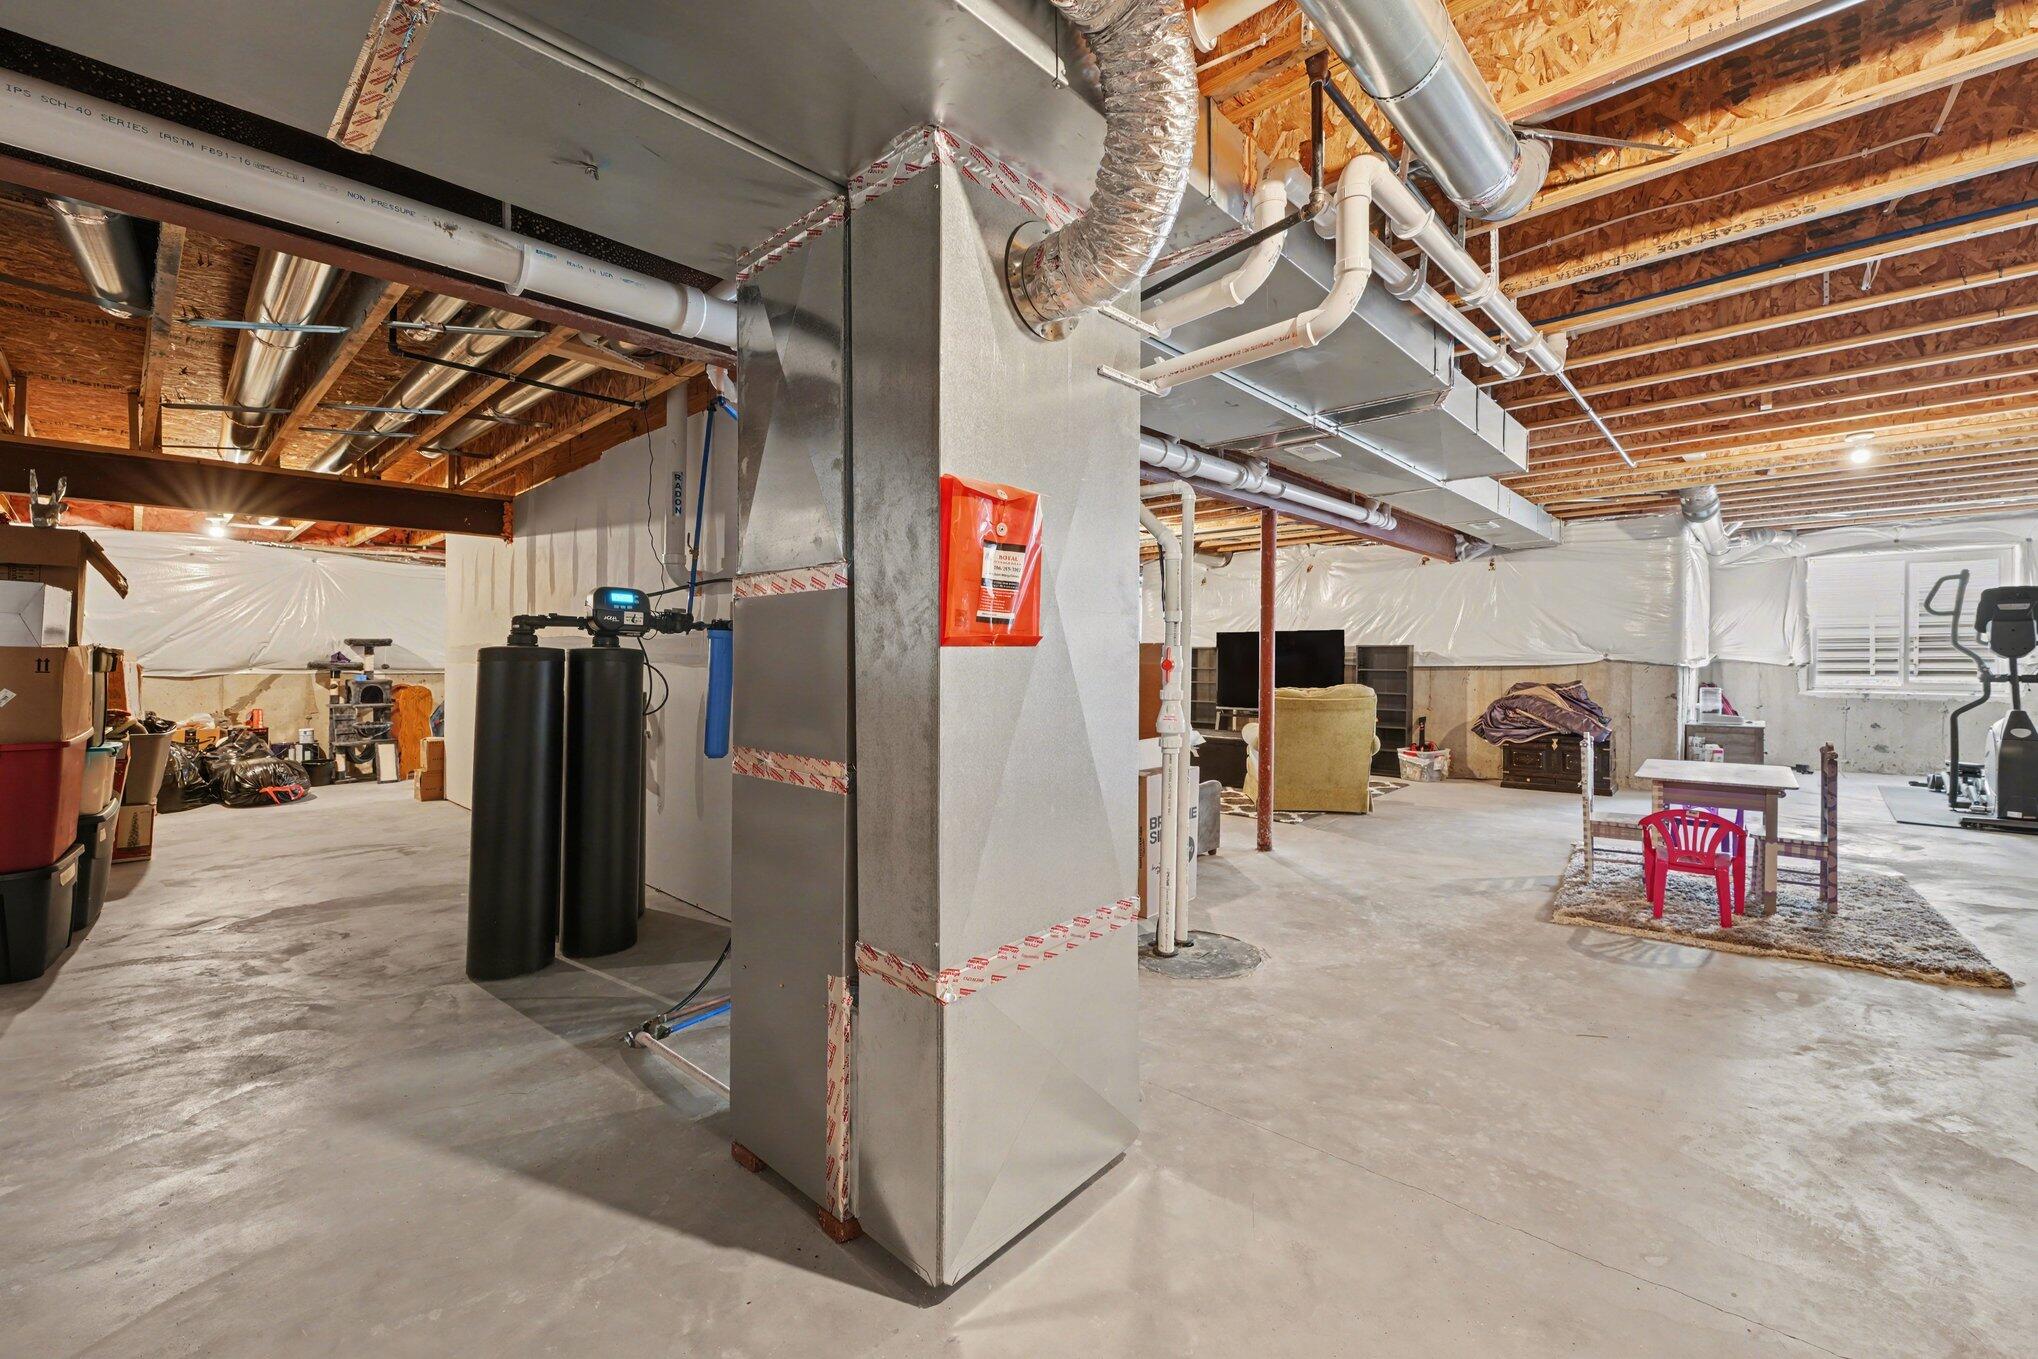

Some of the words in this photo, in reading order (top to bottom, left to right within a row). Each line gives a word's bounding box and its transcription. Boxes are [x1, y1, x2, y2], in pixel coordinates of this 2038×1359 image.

[5, 83, 32, 98] IPS
[40, 95, 93, 117] SCH-40
[100, 113, 150, 135] SERIES
[346, 190, 367, 203] NON
[370, 198, 417, 218] PRESSURE
[673, 473, 683, 516] RADON
